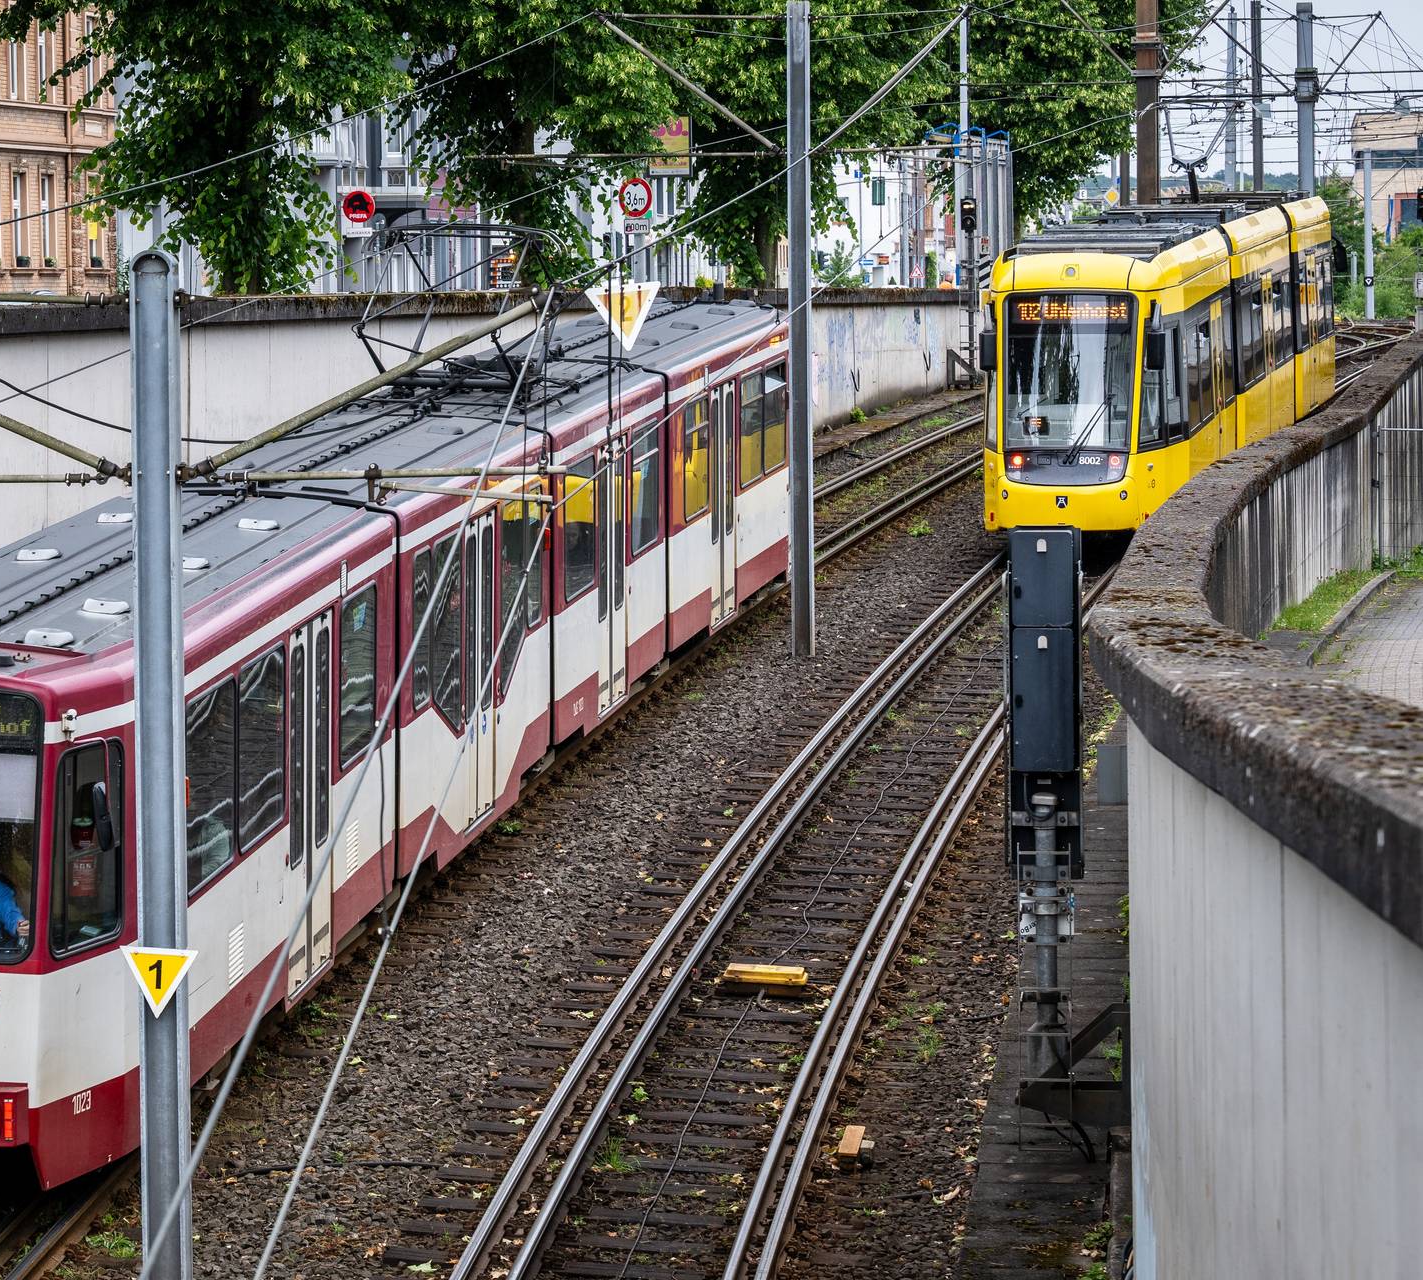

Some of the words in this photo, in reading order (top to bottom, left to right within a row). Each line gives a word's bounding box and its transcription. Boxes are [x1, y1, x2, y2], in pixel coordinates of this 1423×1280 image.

[1017, 303, 1041, 320] 102
[1043, 302, 1127, 319] Uhlenhorst
[1079, 456, 1101, 465] 8002
[148, 959, 163, 990] 1
[71, 1089, 92, 1115] 1023
